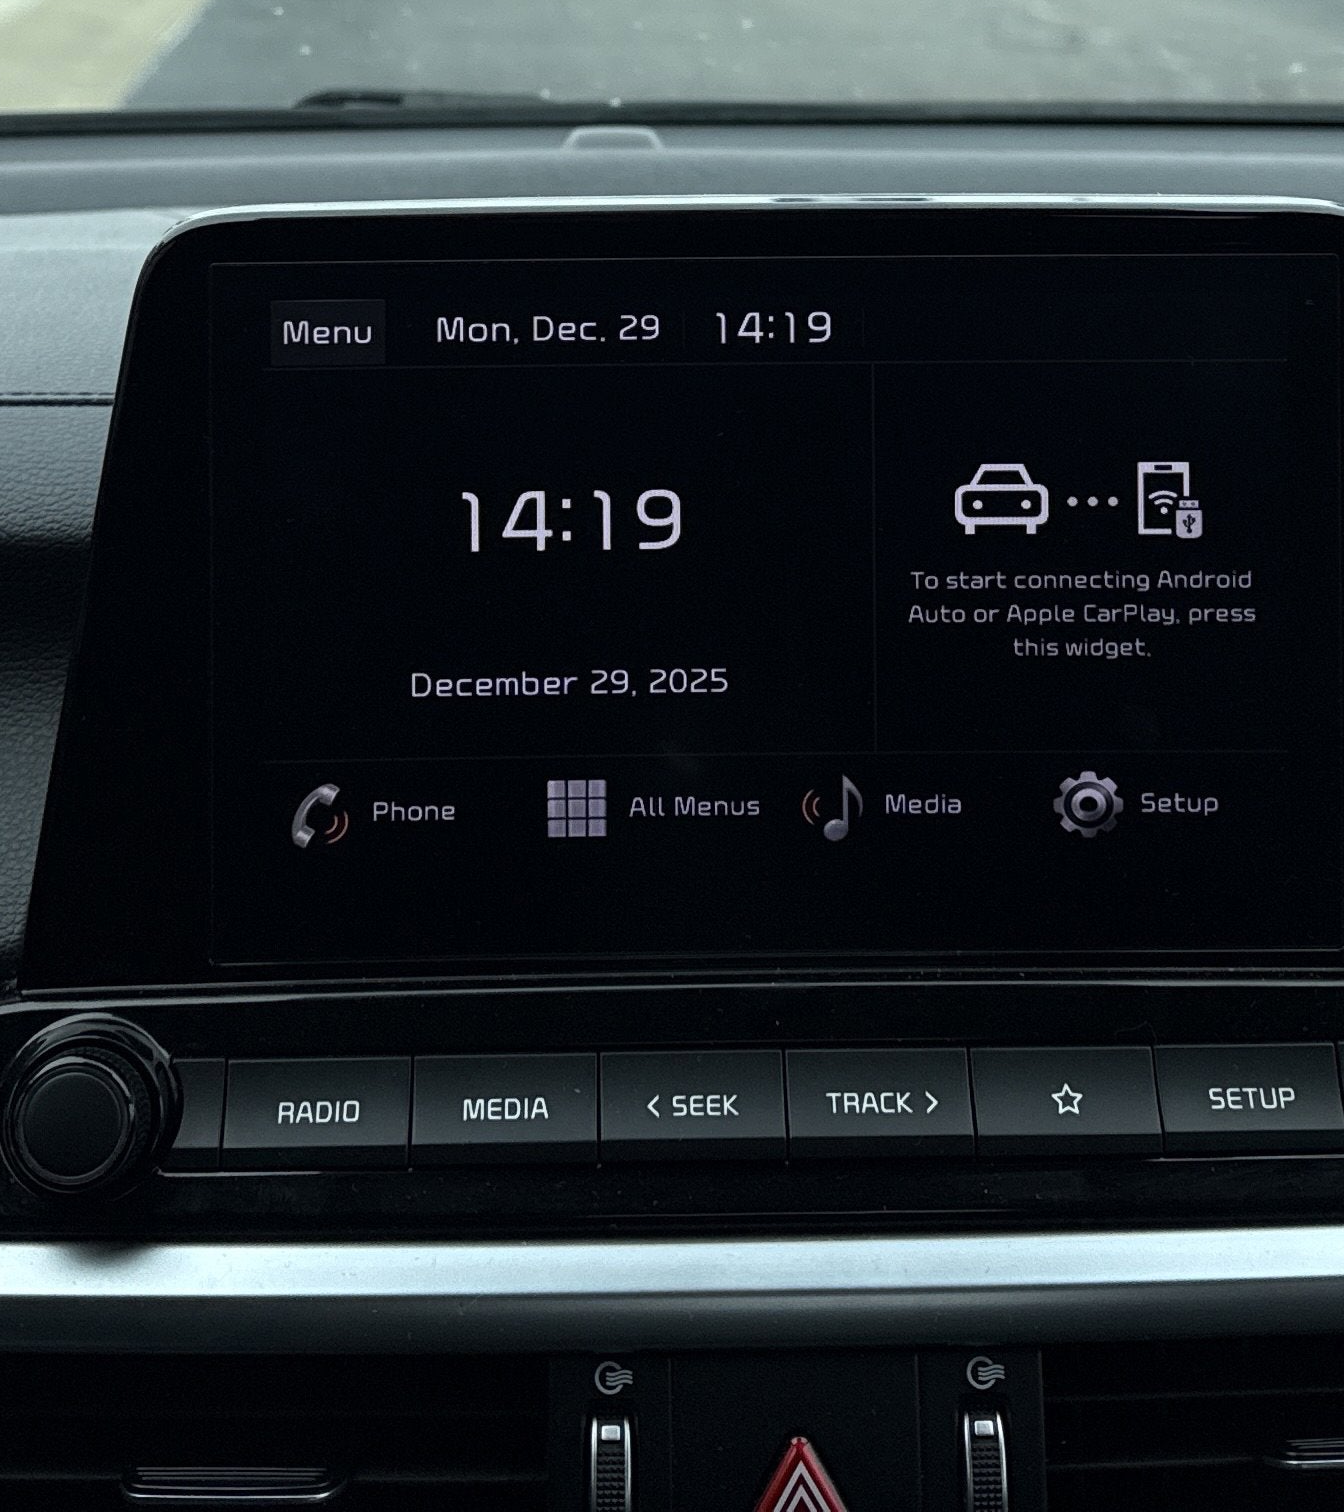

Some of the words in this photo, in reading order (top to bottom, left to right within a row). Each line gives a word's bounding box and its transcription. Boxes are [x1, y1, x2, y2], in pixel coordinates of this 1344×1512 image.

[283, 320, 372, 345] Menu
[532, 315, 606, 342] Dec.
[619, 314, 660, 341] 29
[715, 311, 832, 345] 14:19
[461, 488, 681, 553] 14:19
[910, 571, 939, 590] To
[946, 571, 1007, 590] start
[1014, 570, 1150, 592] connecting
[1157, 569, 1252, 589] Android
[908, 604, 966, 623] Auto
[973, 608, 1000, 623] or
[1006, 604, 1075, 626] Apple
[1189, 607, 1256, 625] press
[1013, 638, 1059, 656] this
[1065, 638, 1152, 659] widget.
[411, 670, 578, 698] December
[590, 669, 637, 697] 29,
[649, 668, 729, 694] 2025
[373, 801, 456, 822] Phone
[629, 796, 665, 817] All
[674, 796, 760, 817] Menus
[885, 793, 962, 814] Media
[1141, 792, 1219, 816] Setup
[462, 1096, 549, 1122] MEDIA
[672, 1094, 740, 1117] SEEK
[825, 1091, 914, 1114] TRACK
[1208, 1087, 1296, 1110] SETUP
[277, 1100, 360, 1125] RADIO
